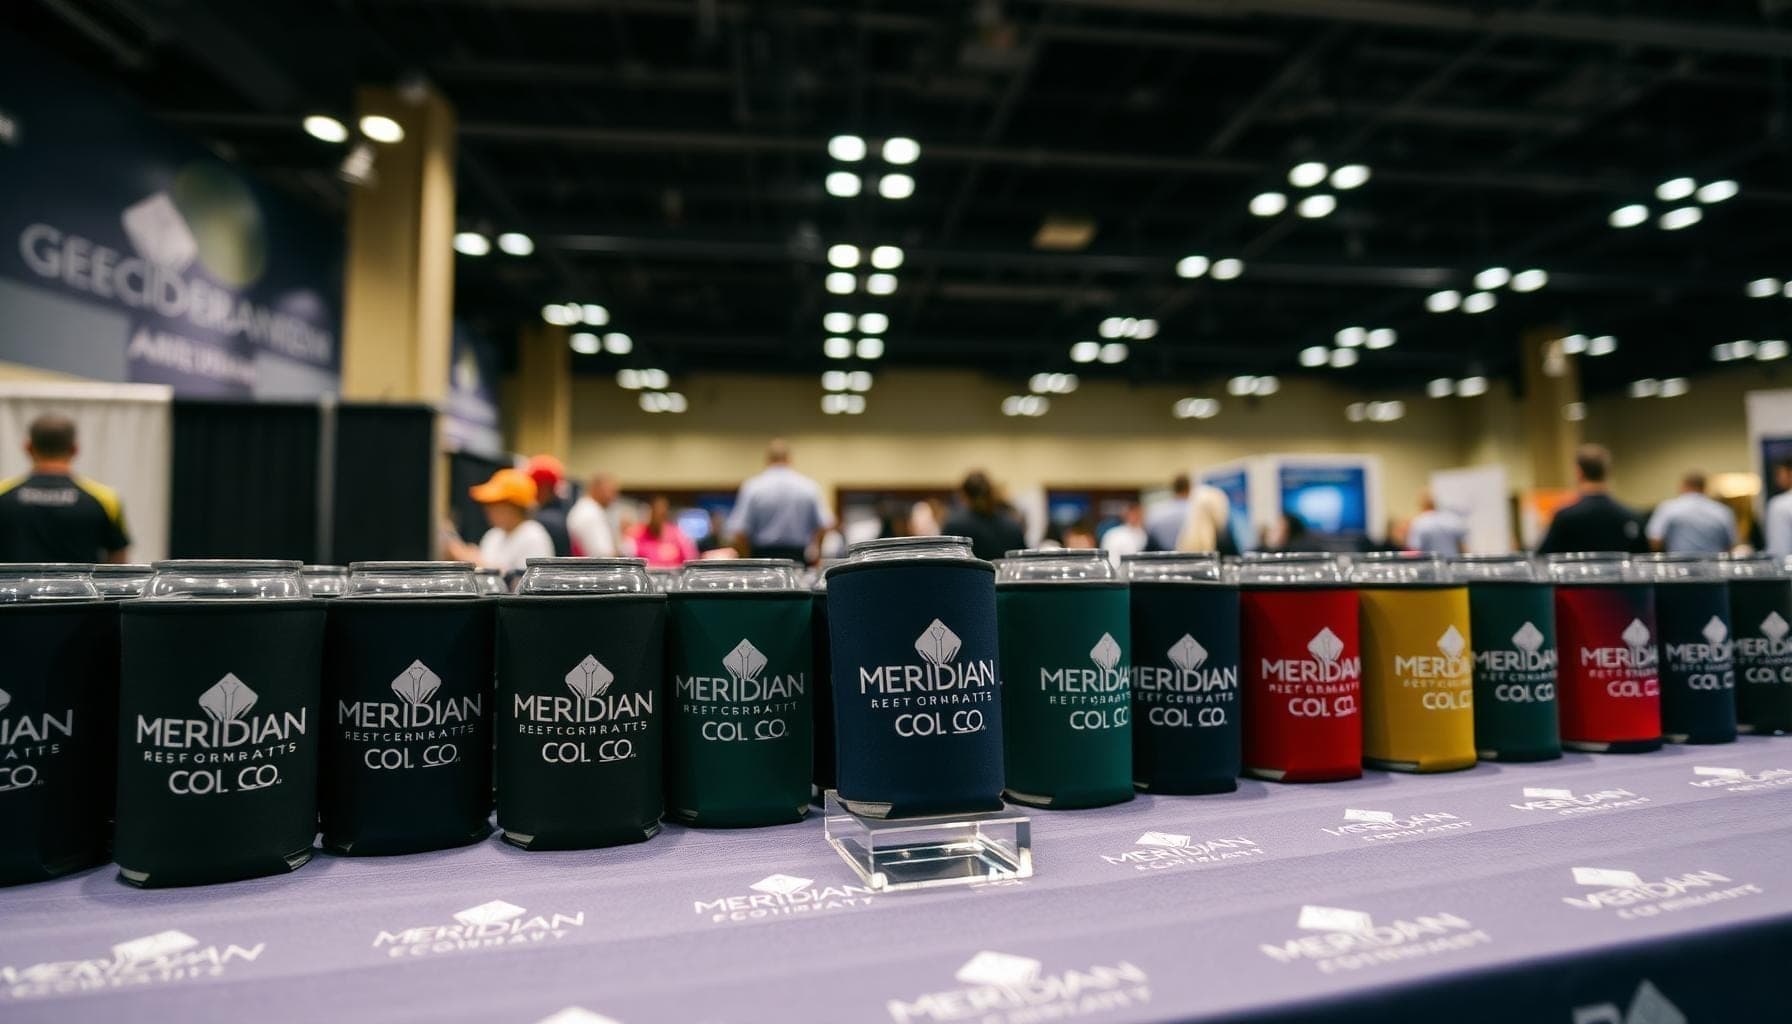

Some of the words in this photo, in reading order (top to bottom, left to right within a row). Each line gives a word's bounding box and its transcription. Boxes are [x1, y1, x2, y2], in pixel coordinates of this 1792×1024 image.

[675, 673, 804, 703] MERIDIAN
[859, 659, 995, 694] MERIDIAN
[1607, 680, 1642, 697] COL
[1423, 692, 1456, 710] COL
[1495, 684, 1530, 702] COL
[338, 693, 482, 728] MERIDIAN
[514, 690, 653, 723] MERIDIAN
[1069, 706, 1110, 730] COL
[1149, 707, 1193, 728] COL
[1288, 698, 1330, 717] COL
[136, 706, 306, 749] MERIDIAN
[702, 721, 748, 741] COL
[895, 711, 947, 737] COL
[364, 747, 414, 770] COL
[542, 742, 591, 763] COL
[168, 769, 229, 795] COL
[372, 911, 584, 947] MERIDIAN
